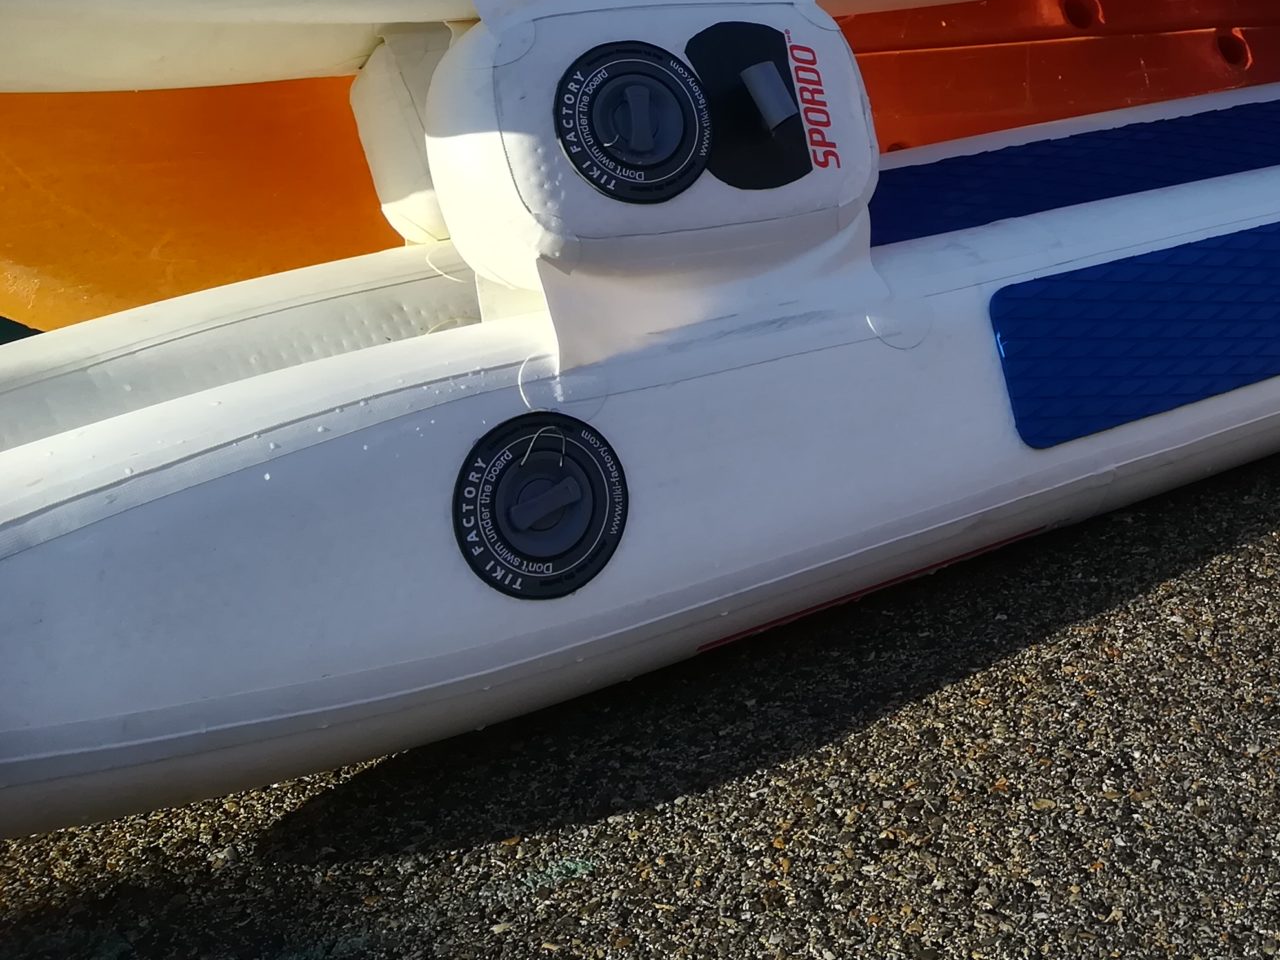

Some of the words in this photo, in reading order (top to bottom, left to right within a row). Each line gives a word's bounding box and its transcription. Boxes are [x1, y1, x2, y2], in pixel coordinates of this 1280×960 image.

[588, 69, 609, 93] board
[563, 70, 587, 154] FACTORY
[578, 95, 590, 112] the
[789, 44, 841, 168] SPORDO
[579, 113, 593, 145] under
[592, 145, 616, 170] swim
[615, 164, 645, 181] Don't
[581, 160, 617, 191] TIKI
[485, 450, 513, 482] board
[480, 484, 493, 504] the
[581, 429, 624, 535] www.tiki-factory.com
[462, 456, 488, 557] FACTORY
[480, 506, 498, 542] under
[494, 541, 523, 567] swim
[522, 560, 553, 575] Don't
[484, 559, 524, 590] TIKI
